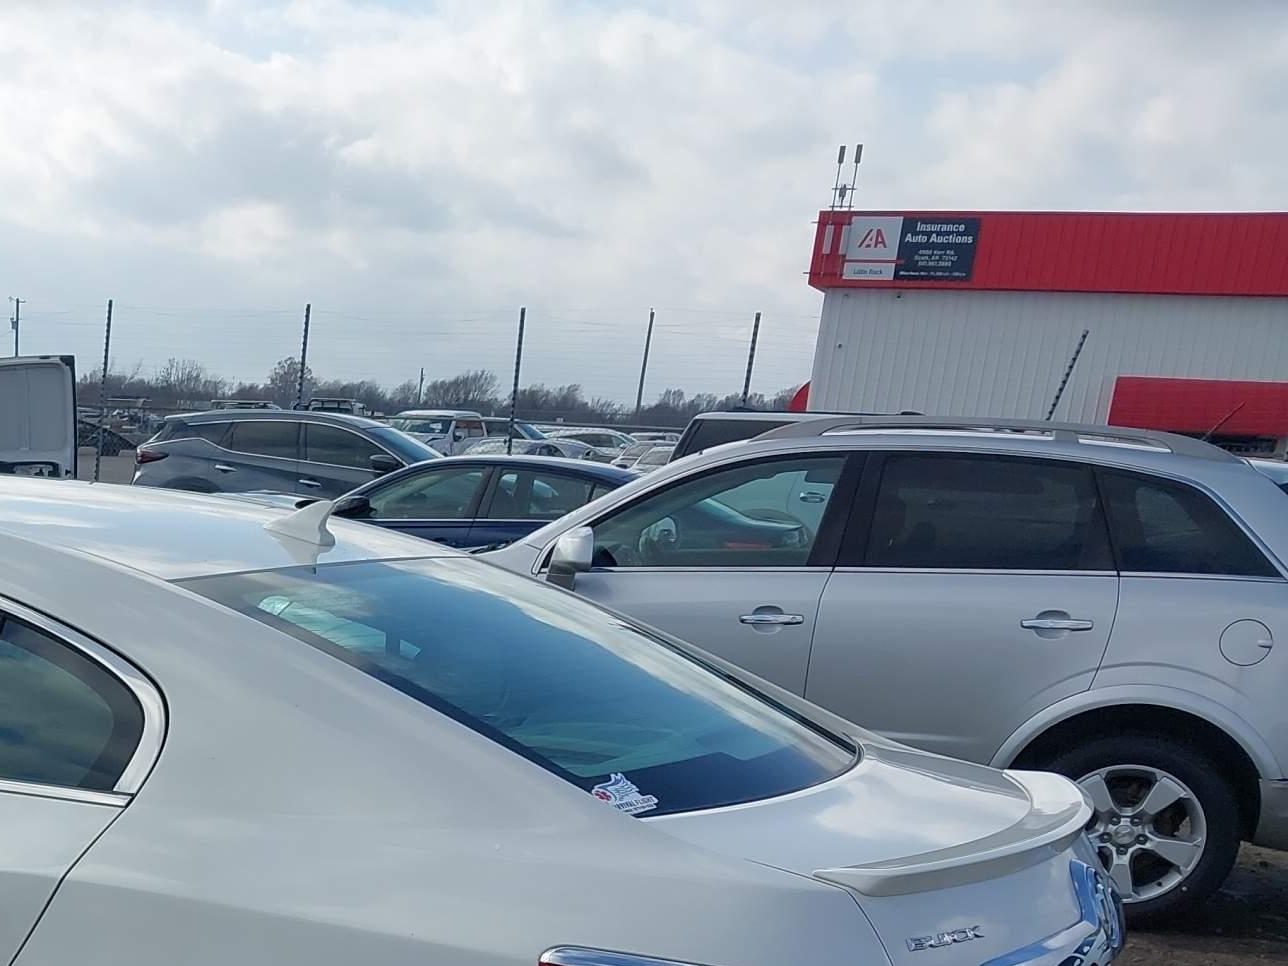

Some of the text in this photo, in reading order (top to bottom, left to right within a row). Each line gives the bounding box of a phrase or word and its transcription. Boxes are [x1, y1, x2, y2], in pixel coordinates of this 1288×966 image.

[916, 221, 965, 232] Insurance
[904, 233, 974, 244] Auto Auctions
[905, 925, 985, 952] BUICK
